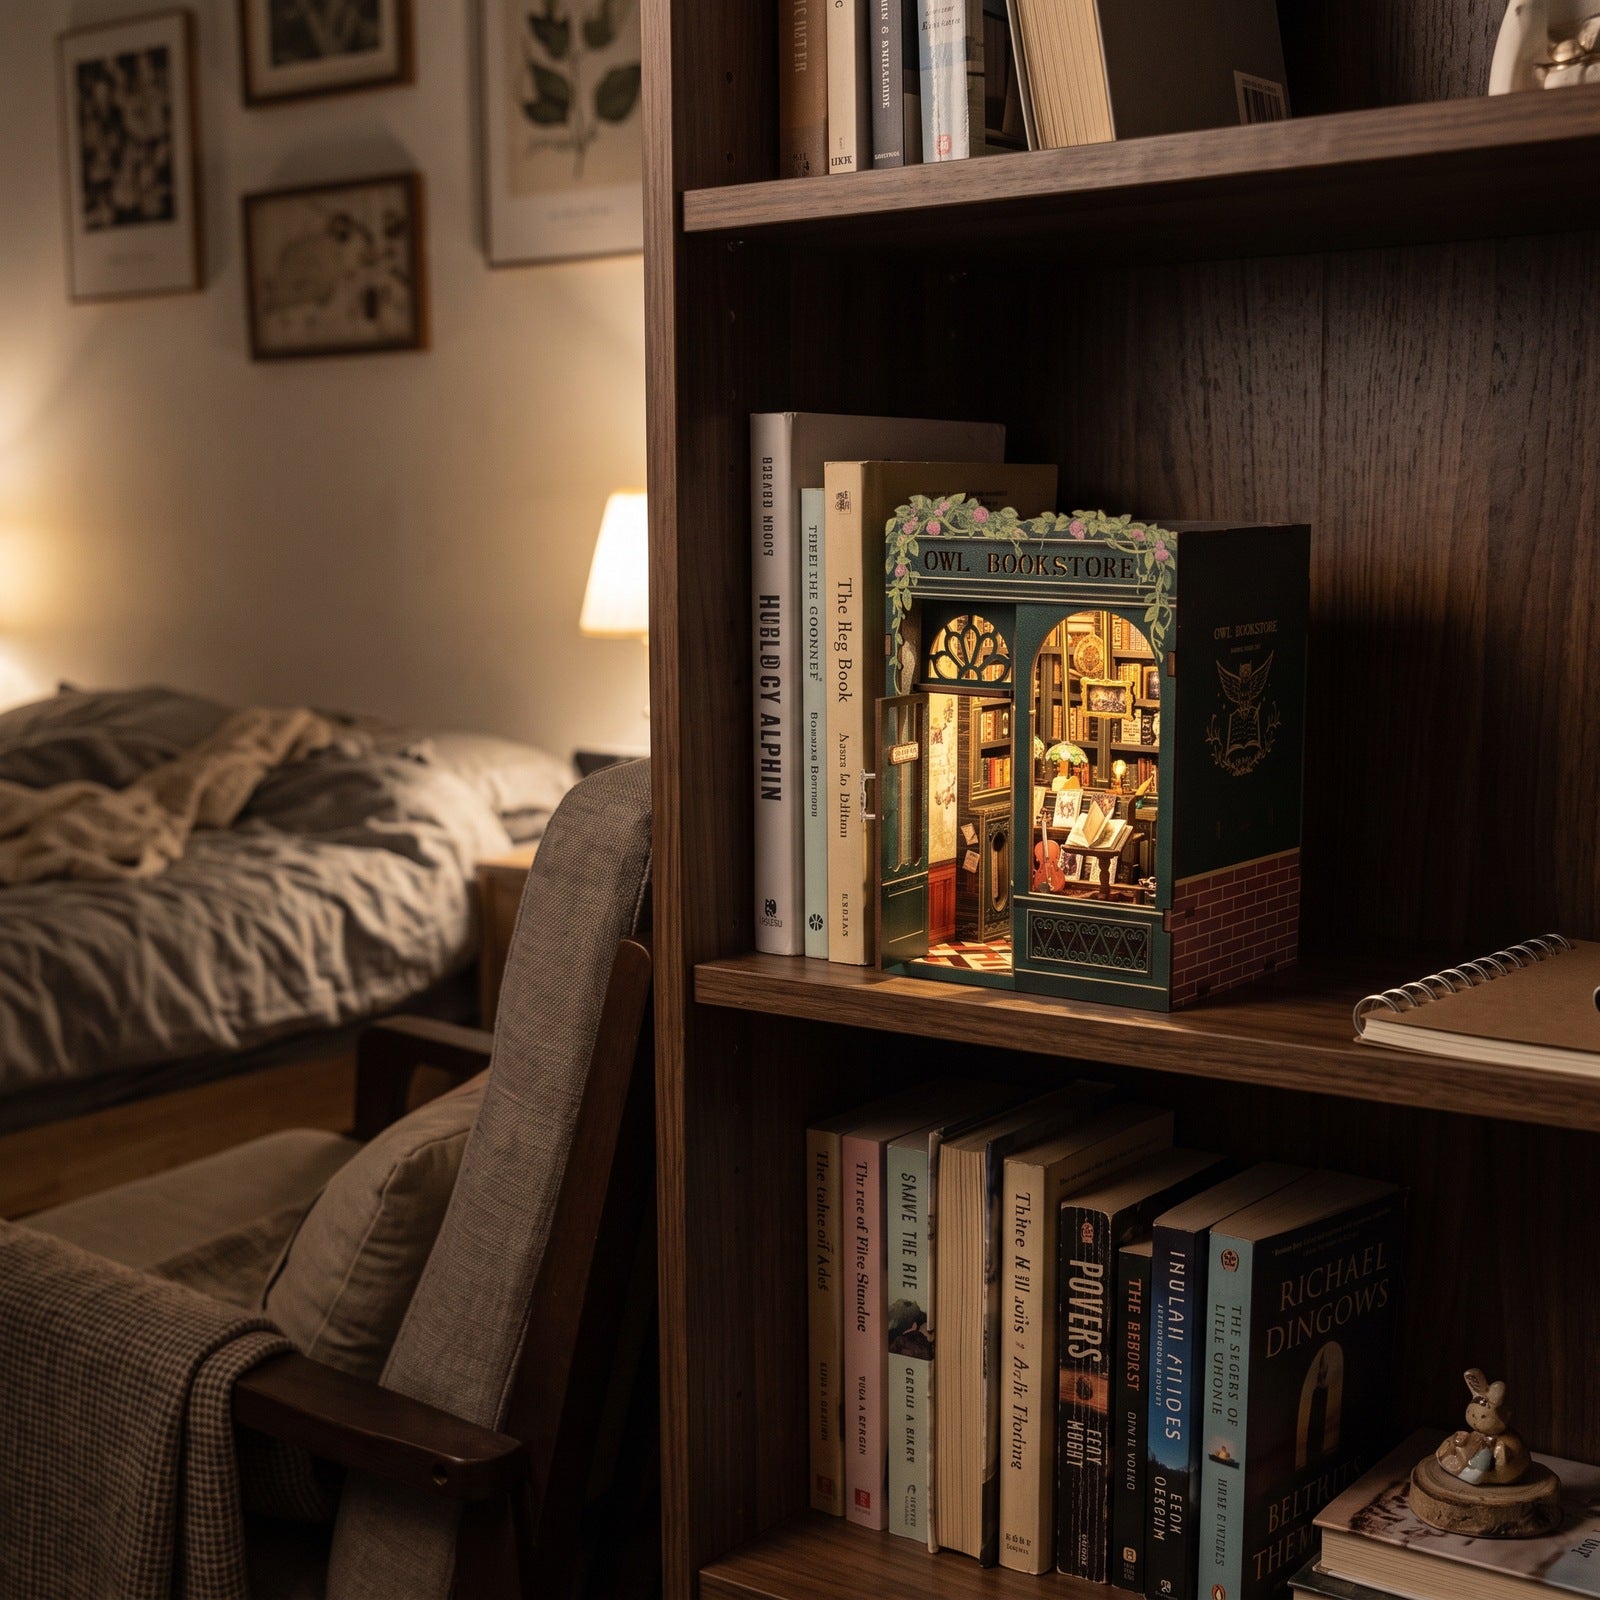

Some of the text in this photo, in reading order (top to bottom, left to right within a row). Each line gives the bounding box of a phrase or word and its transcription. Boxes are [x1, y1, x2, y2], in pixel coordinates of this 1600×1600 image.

[924, 550, 1135, 580] OWL BOOKSTORE
[837, 578, 852, 614] The
[1213, 625, 1233, 640] OWL
[838, 658, 853, 703] Book
[760, 713, 781, 801] ALPHIN
[856, 1217, 869, 1233] of
[902, 1231, 917, 1257] THE
[1280, 1242, 1387, 1312] RICHAEL
[1067, 1259, 1104, 1363] POVERS
[1127, 1278, 1142, 1314] THE
[1230, 1305, 1242, 1336] THE
[1265, 1278, 1390, 1359] DINGOWS
[1227, 1408, 1238, 1427] OF
